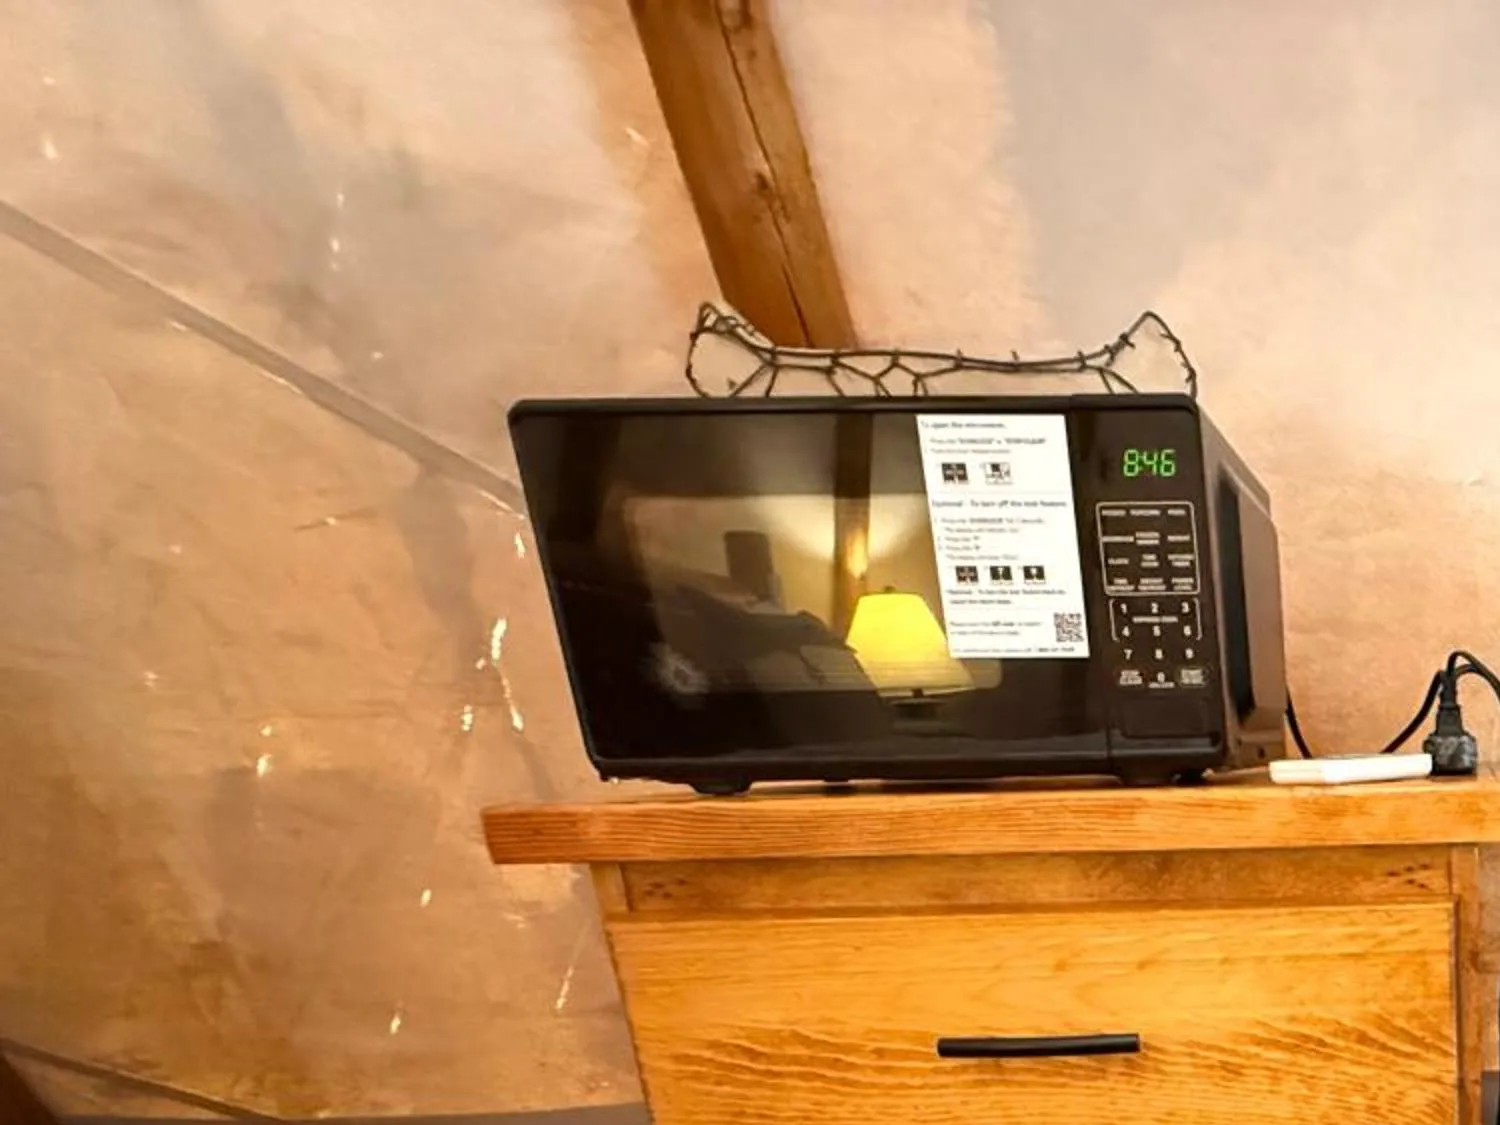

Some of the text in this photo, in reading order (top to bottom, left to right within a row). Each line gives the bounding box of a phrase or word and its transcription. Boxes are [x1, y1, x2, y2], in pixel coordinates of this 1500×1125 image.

[1120, 602, 1190, 614] 1 2 3
[1122, 625, 1192, 637] 4 5 6
[1124, 648, 1194, 660] 7 8 9
